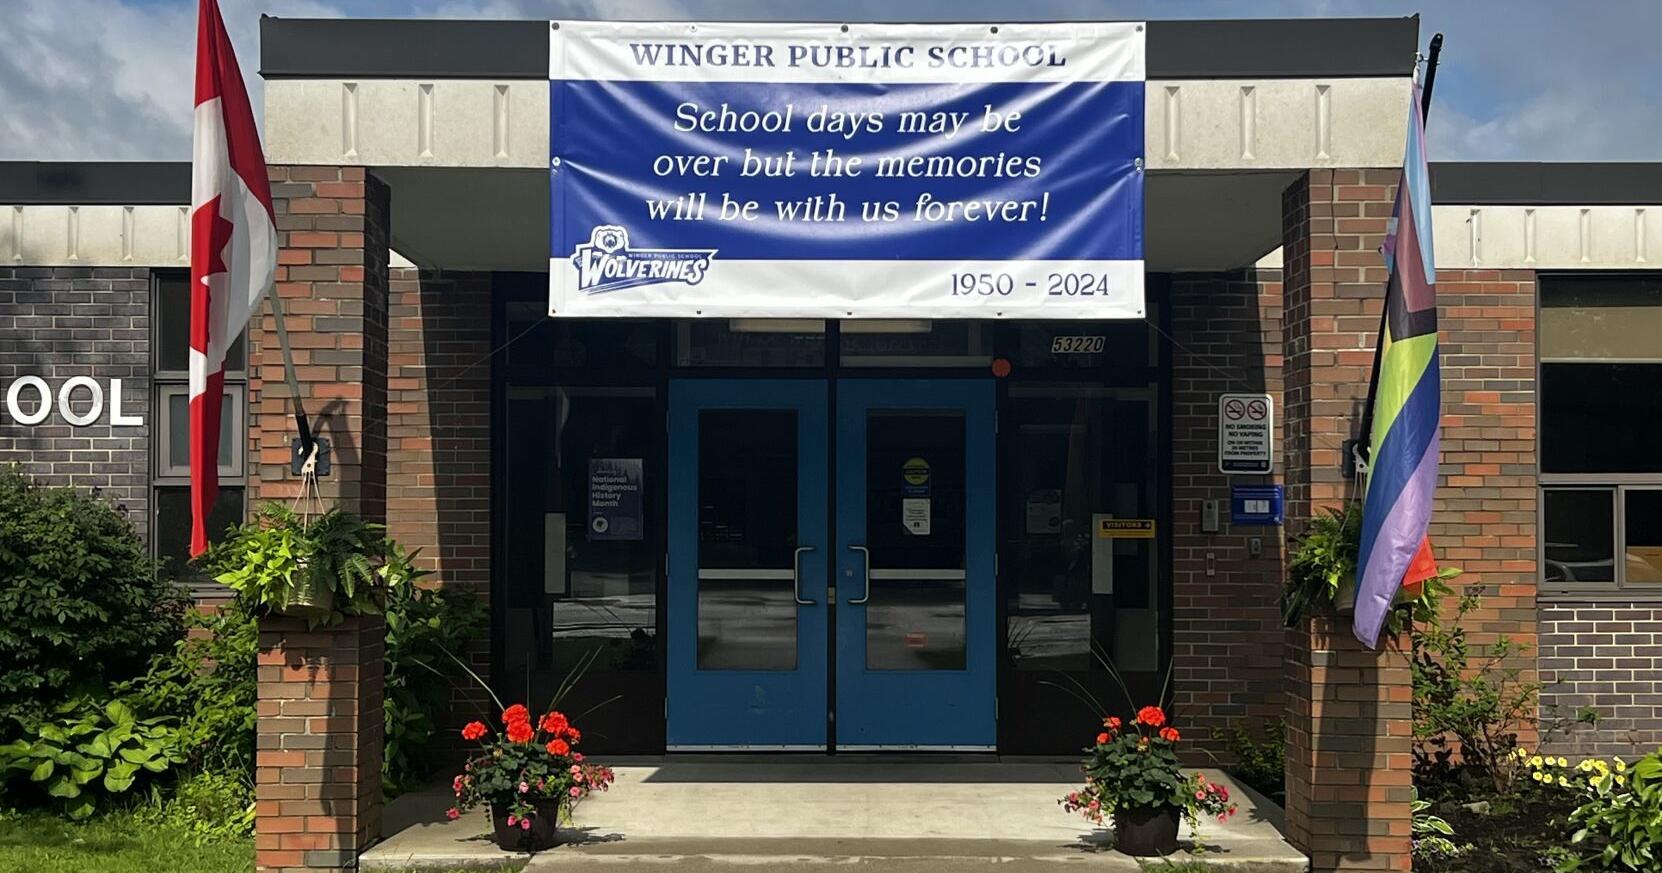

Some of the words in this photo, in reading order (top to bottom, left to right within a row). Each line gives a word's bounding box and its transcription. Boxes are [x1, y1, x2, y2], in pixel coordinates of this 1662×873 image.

[630, 43, 775, 68] WINGER
[788, 45, 914, 68] PUBLIC
[928, 45, 1066, 68] SCHOOL
[674, 103, 793, 133] School
[807, 103, 884, 139] days
[897, 109, 969, 138] may
[983, 104, 1021, 132] be
[653, 157, 728, 178] over
[743, 149, 796, 177] but
[810, 149, 862, 177] the
[875, 151, 1042, 178] memories
[646, 193, 707, 222] will
[719, 193, 760, 222] be
[775, 193, 846, 222] with
[862, 200, 900, 222] us
[913, 191, 1050, 224] forever!
[580, 248, 707, 289] WOLVERINES
[950, 273, 1014, 296] 1950
[1047, 273, 1110, 296] 2024
[1054, 337, 1104, 352] 53220
[7, 375, 144, 426] OOL
[591, 484, 638, 493] Indigenous
[592, 492, 622, 501] History
